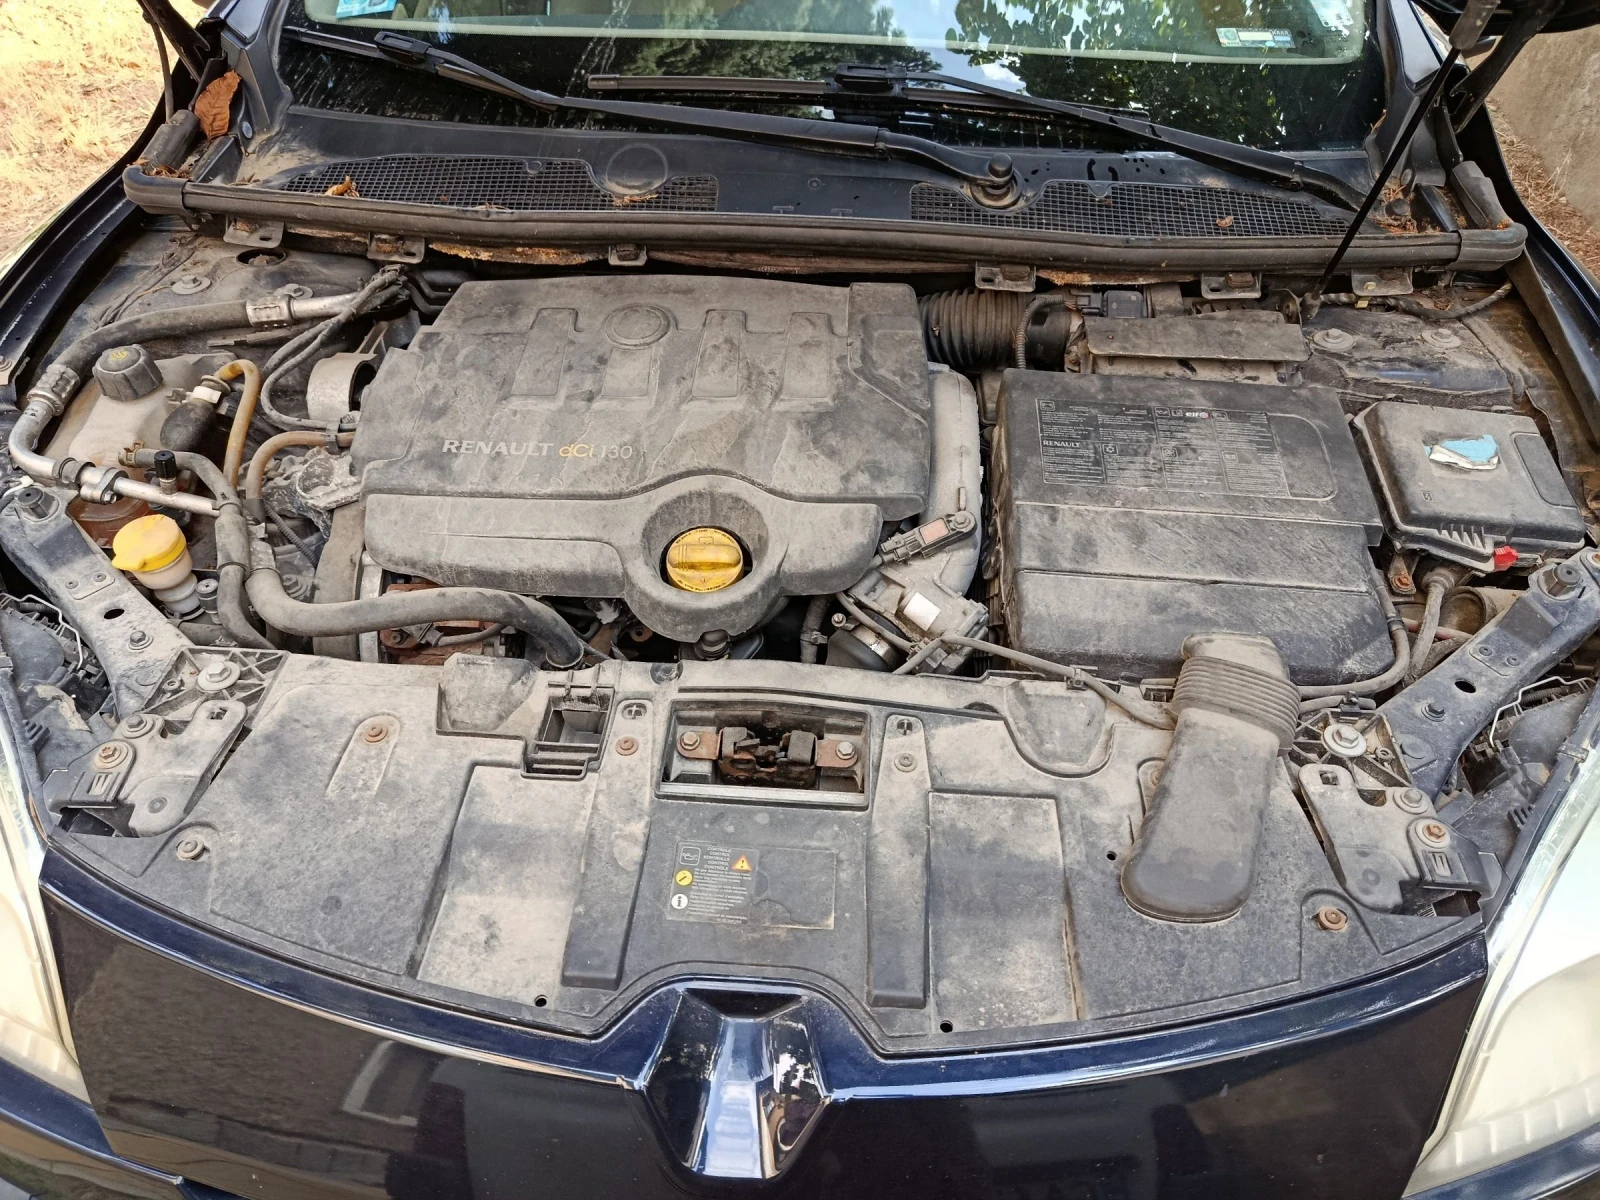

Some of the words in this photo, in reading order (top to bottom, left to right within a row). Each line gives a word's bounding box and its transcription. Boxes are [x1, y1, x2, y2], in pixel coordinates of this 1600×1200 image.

[442, 439, 554, 457] RENAULT
[558, 443, 594, 458] dCi
[600, 445, 633, 459] 130
[1042, 440, 1081, 448] RENAULT
